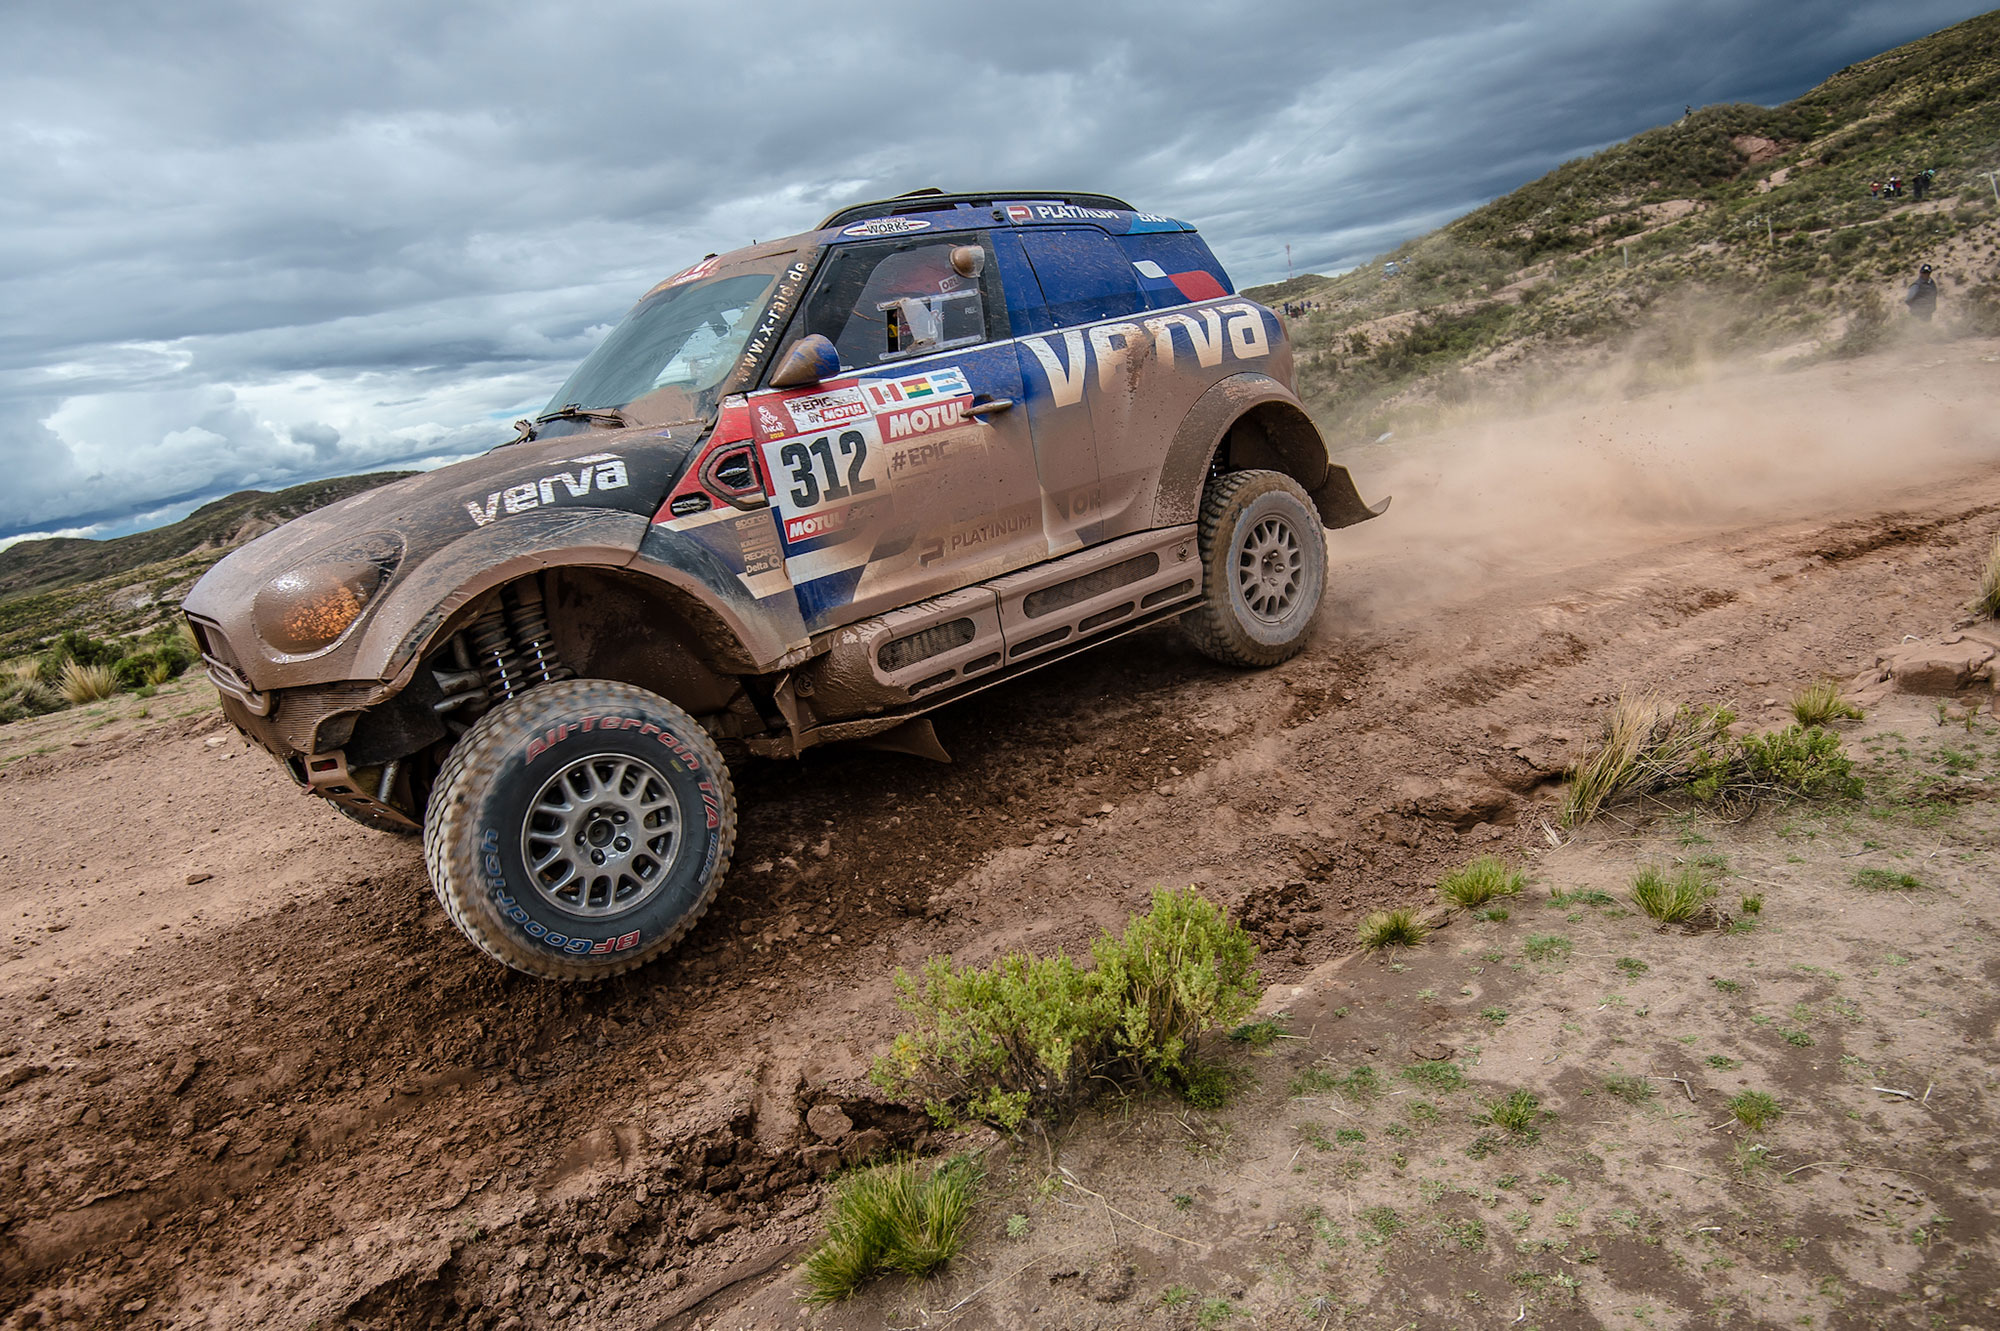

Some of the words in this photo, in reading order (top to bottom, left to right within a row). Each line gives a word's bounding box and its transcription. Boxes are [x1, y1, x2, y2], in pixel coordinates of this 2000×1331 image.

[867, 222, 909, 233] WORKS
[733, 262, 809, 383] www.x-raid.de
[822, 403, 865, 420] MOTUL
[889, 401, 970, 439] MOTUL
[780, 430, 876, 508] 312
[465, 460, 629, 527] verva
[788, 512, 842, 538] MOTUL
[951, 513, 1033, 551] PLATINUM
[744, 546, 777, 562] RECARO
[525, 715, 700, 770] All-Terrain
[480, 828, 641, 955] BFGoodrich
